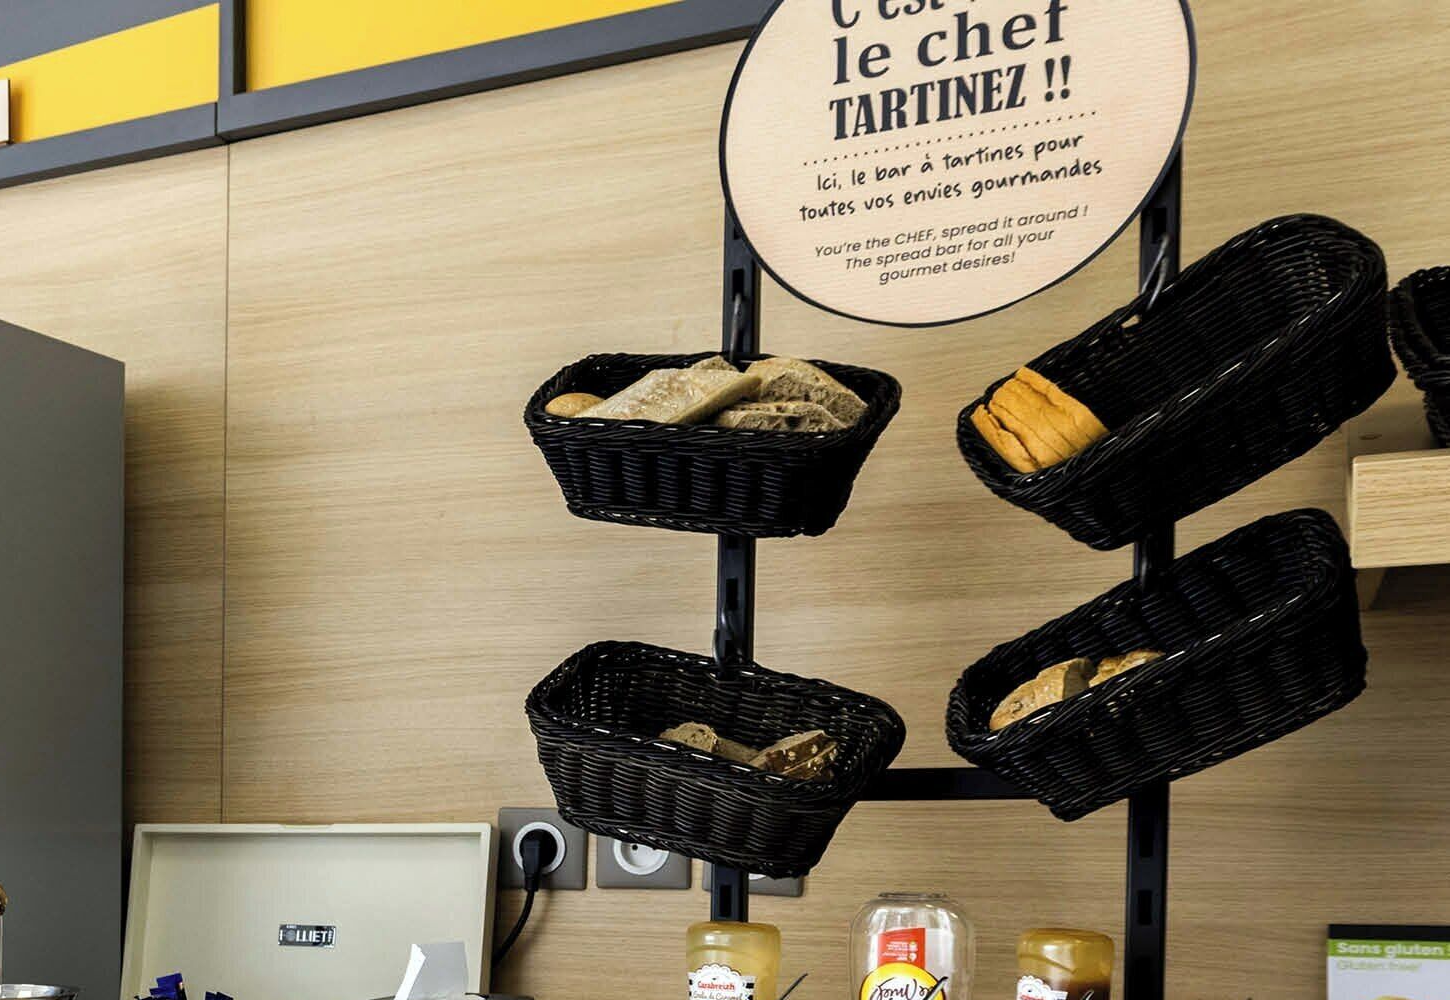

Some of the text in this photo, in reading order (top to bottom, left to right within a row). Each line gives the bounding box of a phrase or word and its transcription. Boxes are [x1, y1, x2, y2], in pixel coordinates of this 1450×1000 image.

[833, 0, 1068, 85] le chef
[829, 55, 1071, 140] TARTINEZ !!
[817, 134, 1084, 191] Ici, le bar à tartines pour
[799, 158, 1103, 222] toutes vos envies gourmandes
[815, 241, 861, 258] You're
[866, 237, 890, 250] the
[894, 229, 938, 246] CHEF,
[941, 218, 999, 242] spread
[1002, 216, 1014, 229] it
[1017, 207, 1078, 227] around
[845, 228, 1055, 271] The spread bar for all your
[879, 251, 1016, 286] gourmet desires!
[1336, 942, 1444, 960] Sans gluten
